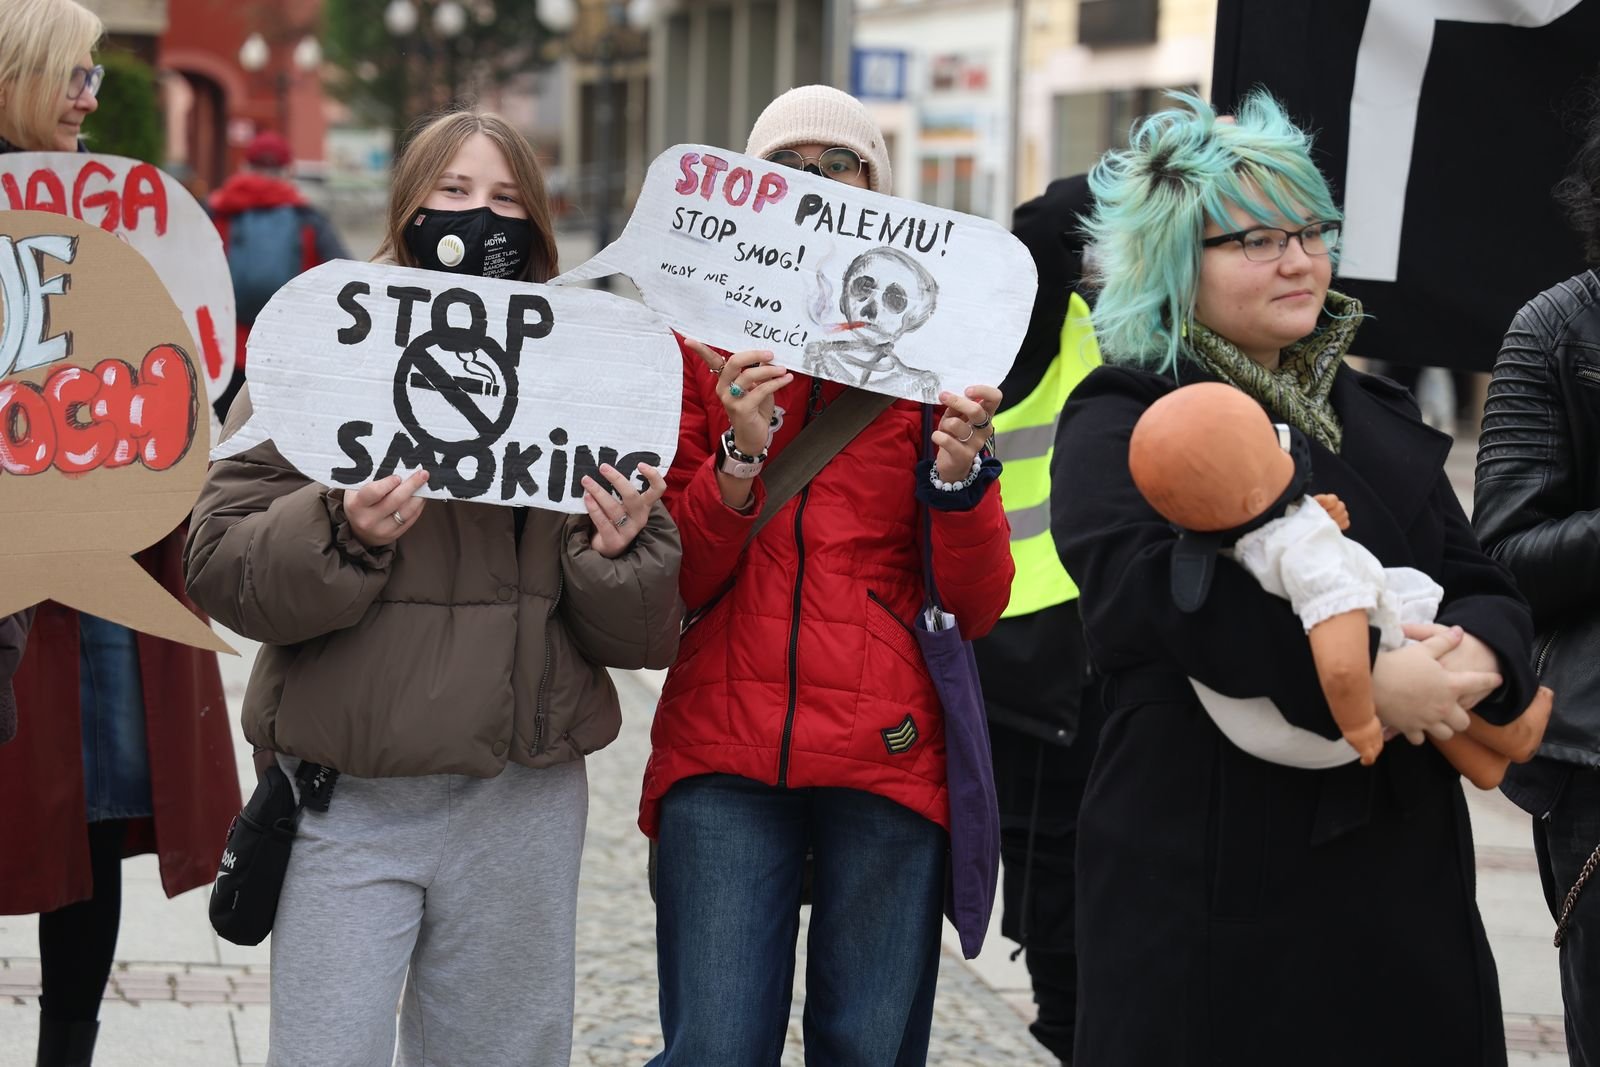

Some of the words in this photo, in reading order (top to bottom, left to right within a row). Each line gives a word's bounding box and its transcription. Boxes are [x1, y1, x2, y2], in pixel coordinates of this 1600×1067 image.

[674, 152, 789, 213] STOP
[795, 193, 955, 256] PALENIU!
[672, 206, 737, 242] STOP
[734, 242, 805, 272] SMOG!
[660, 262, 696, 278] NIGDY
[703, 271, 729, 287] NIE
[725, 284, 782, 313] PÓŹNO
[336, 281, 555, 367] STOP
[743, 319, 808, 348] RZUCIĆ!
[0, 343, 199, 475] OCH
